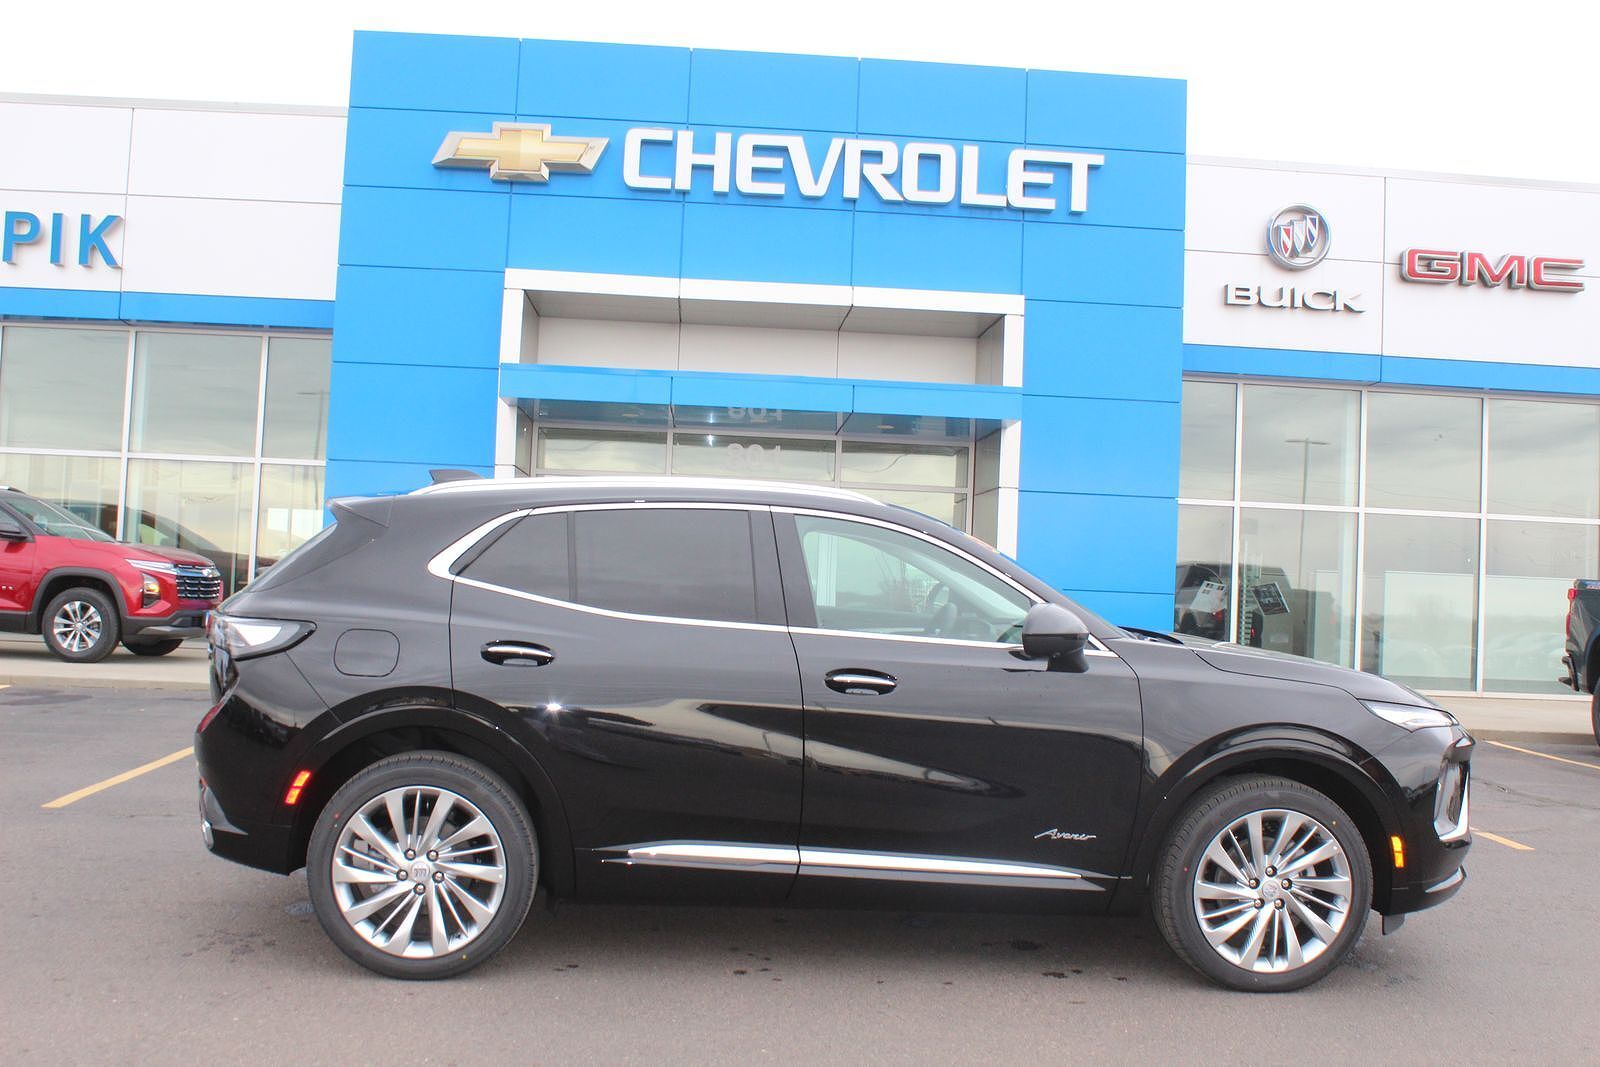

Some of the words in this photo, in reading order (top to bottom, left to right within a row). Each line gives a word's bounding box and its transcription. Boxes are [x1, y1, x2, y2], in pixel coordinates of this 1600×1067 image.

[623, 128, 1105, 213] CHEVROLET
[3, 210, 123, 268] PIK
[1401, 247, 1585, 292] GMC
[1225, 282, 1366, 313] BUICK
